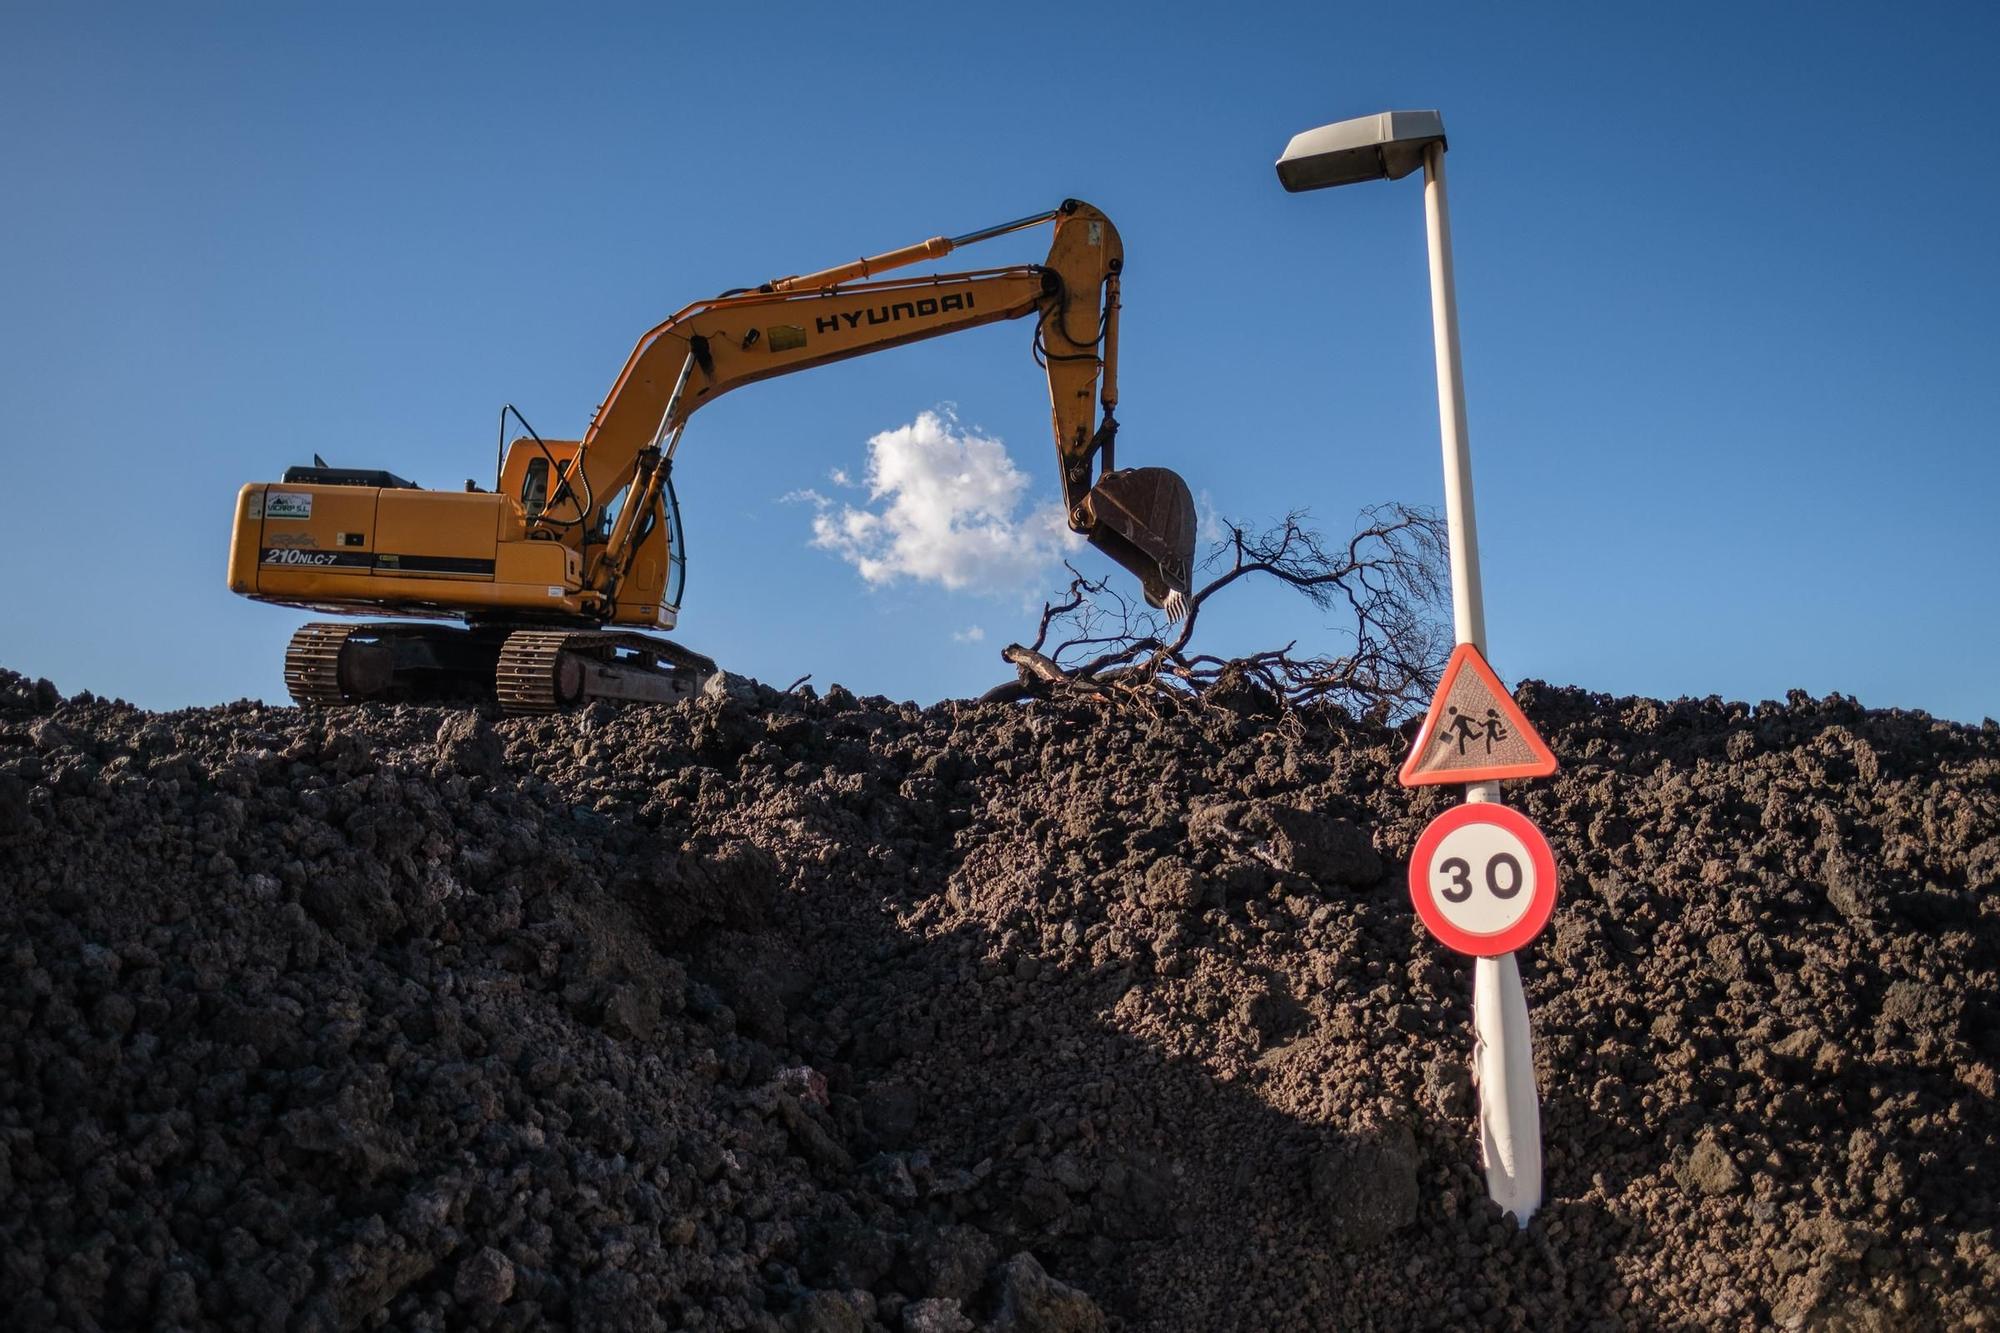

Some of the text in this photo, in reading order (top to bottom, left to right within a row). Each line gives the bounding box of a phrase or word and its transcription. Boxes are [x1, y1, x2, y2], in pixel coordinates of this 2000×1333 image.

[816, 292, 975, 333] HYUNDAI
[265, 549, 337, 565] 210NLC-7
[1439, 852, 1523, 903] 30
